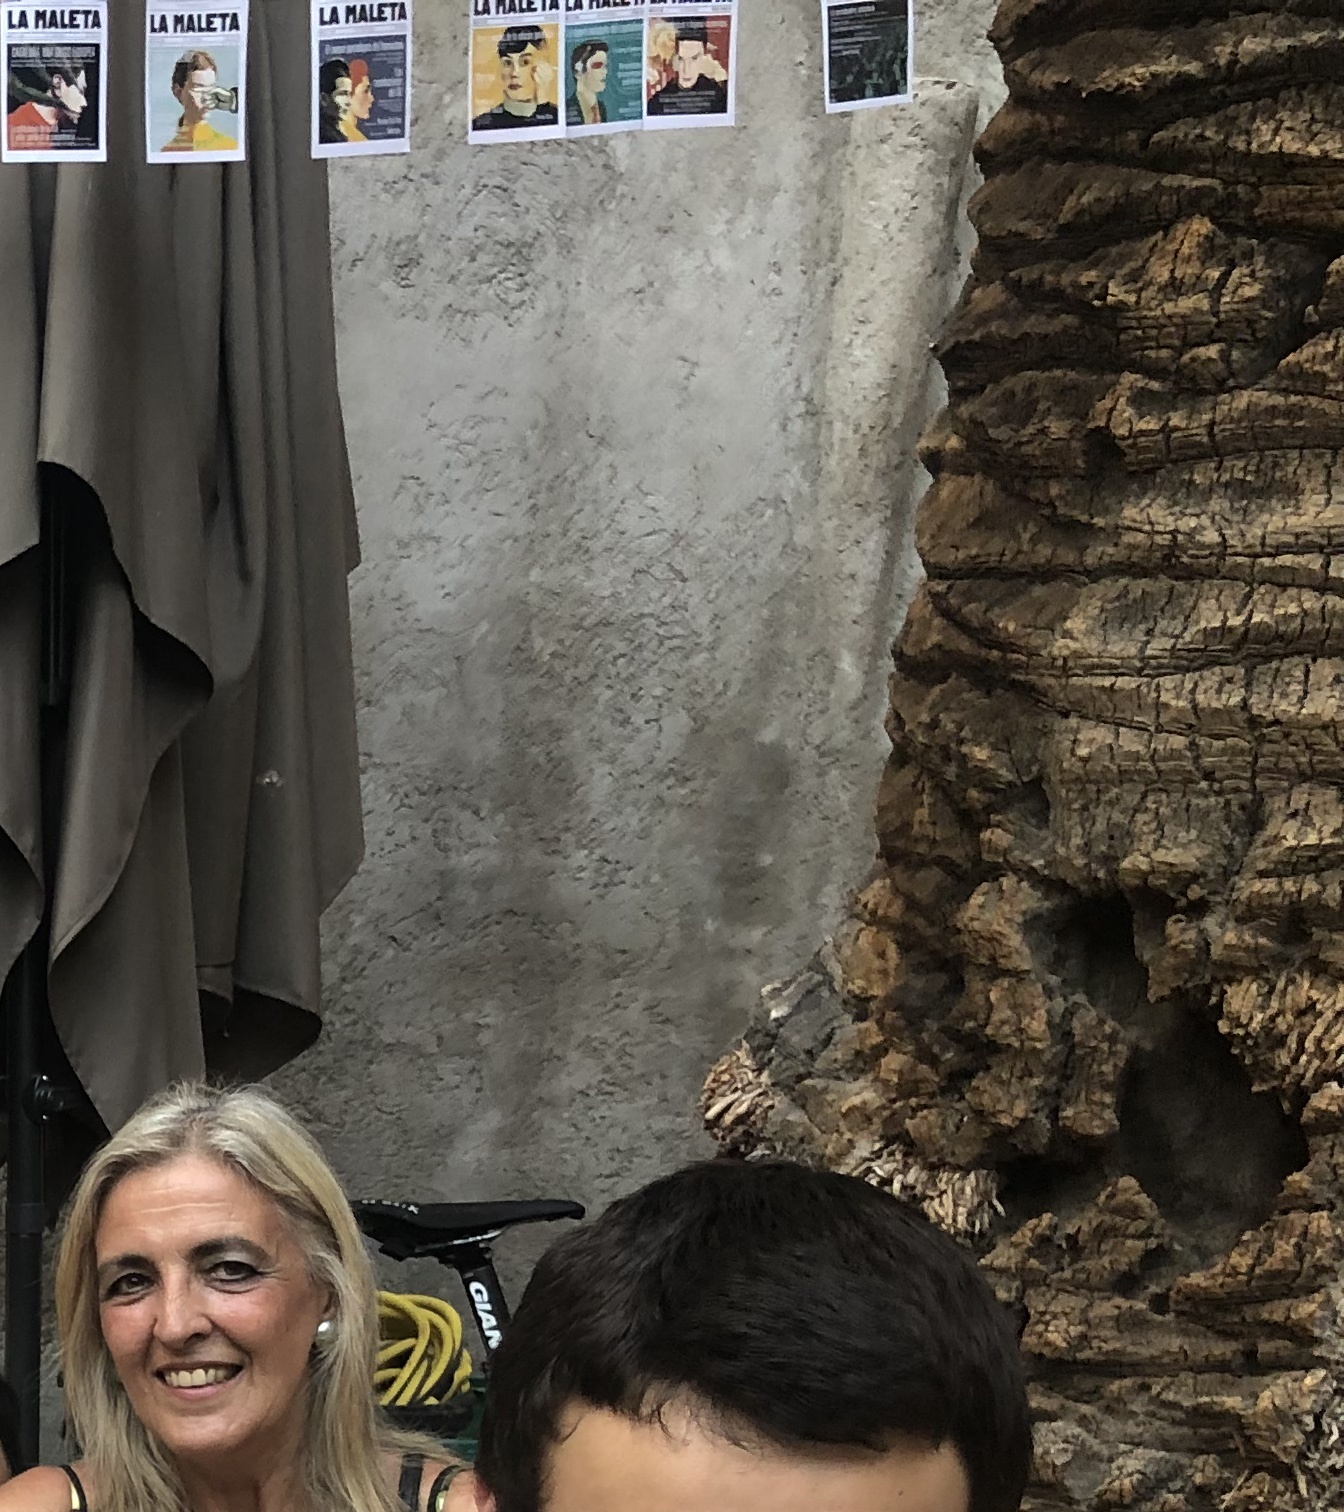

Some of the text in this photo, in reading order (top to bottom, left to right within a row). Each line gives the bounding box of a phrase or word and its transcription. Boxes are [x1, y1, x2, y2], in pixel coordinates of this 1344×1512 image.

[7, 9, 102, 30] LA MALETA
[150, 12, 240, 34] LA MALETA
[319, 2, 408, 26] LA MALETA
[469, 1281, 503, 1351] GIAN
